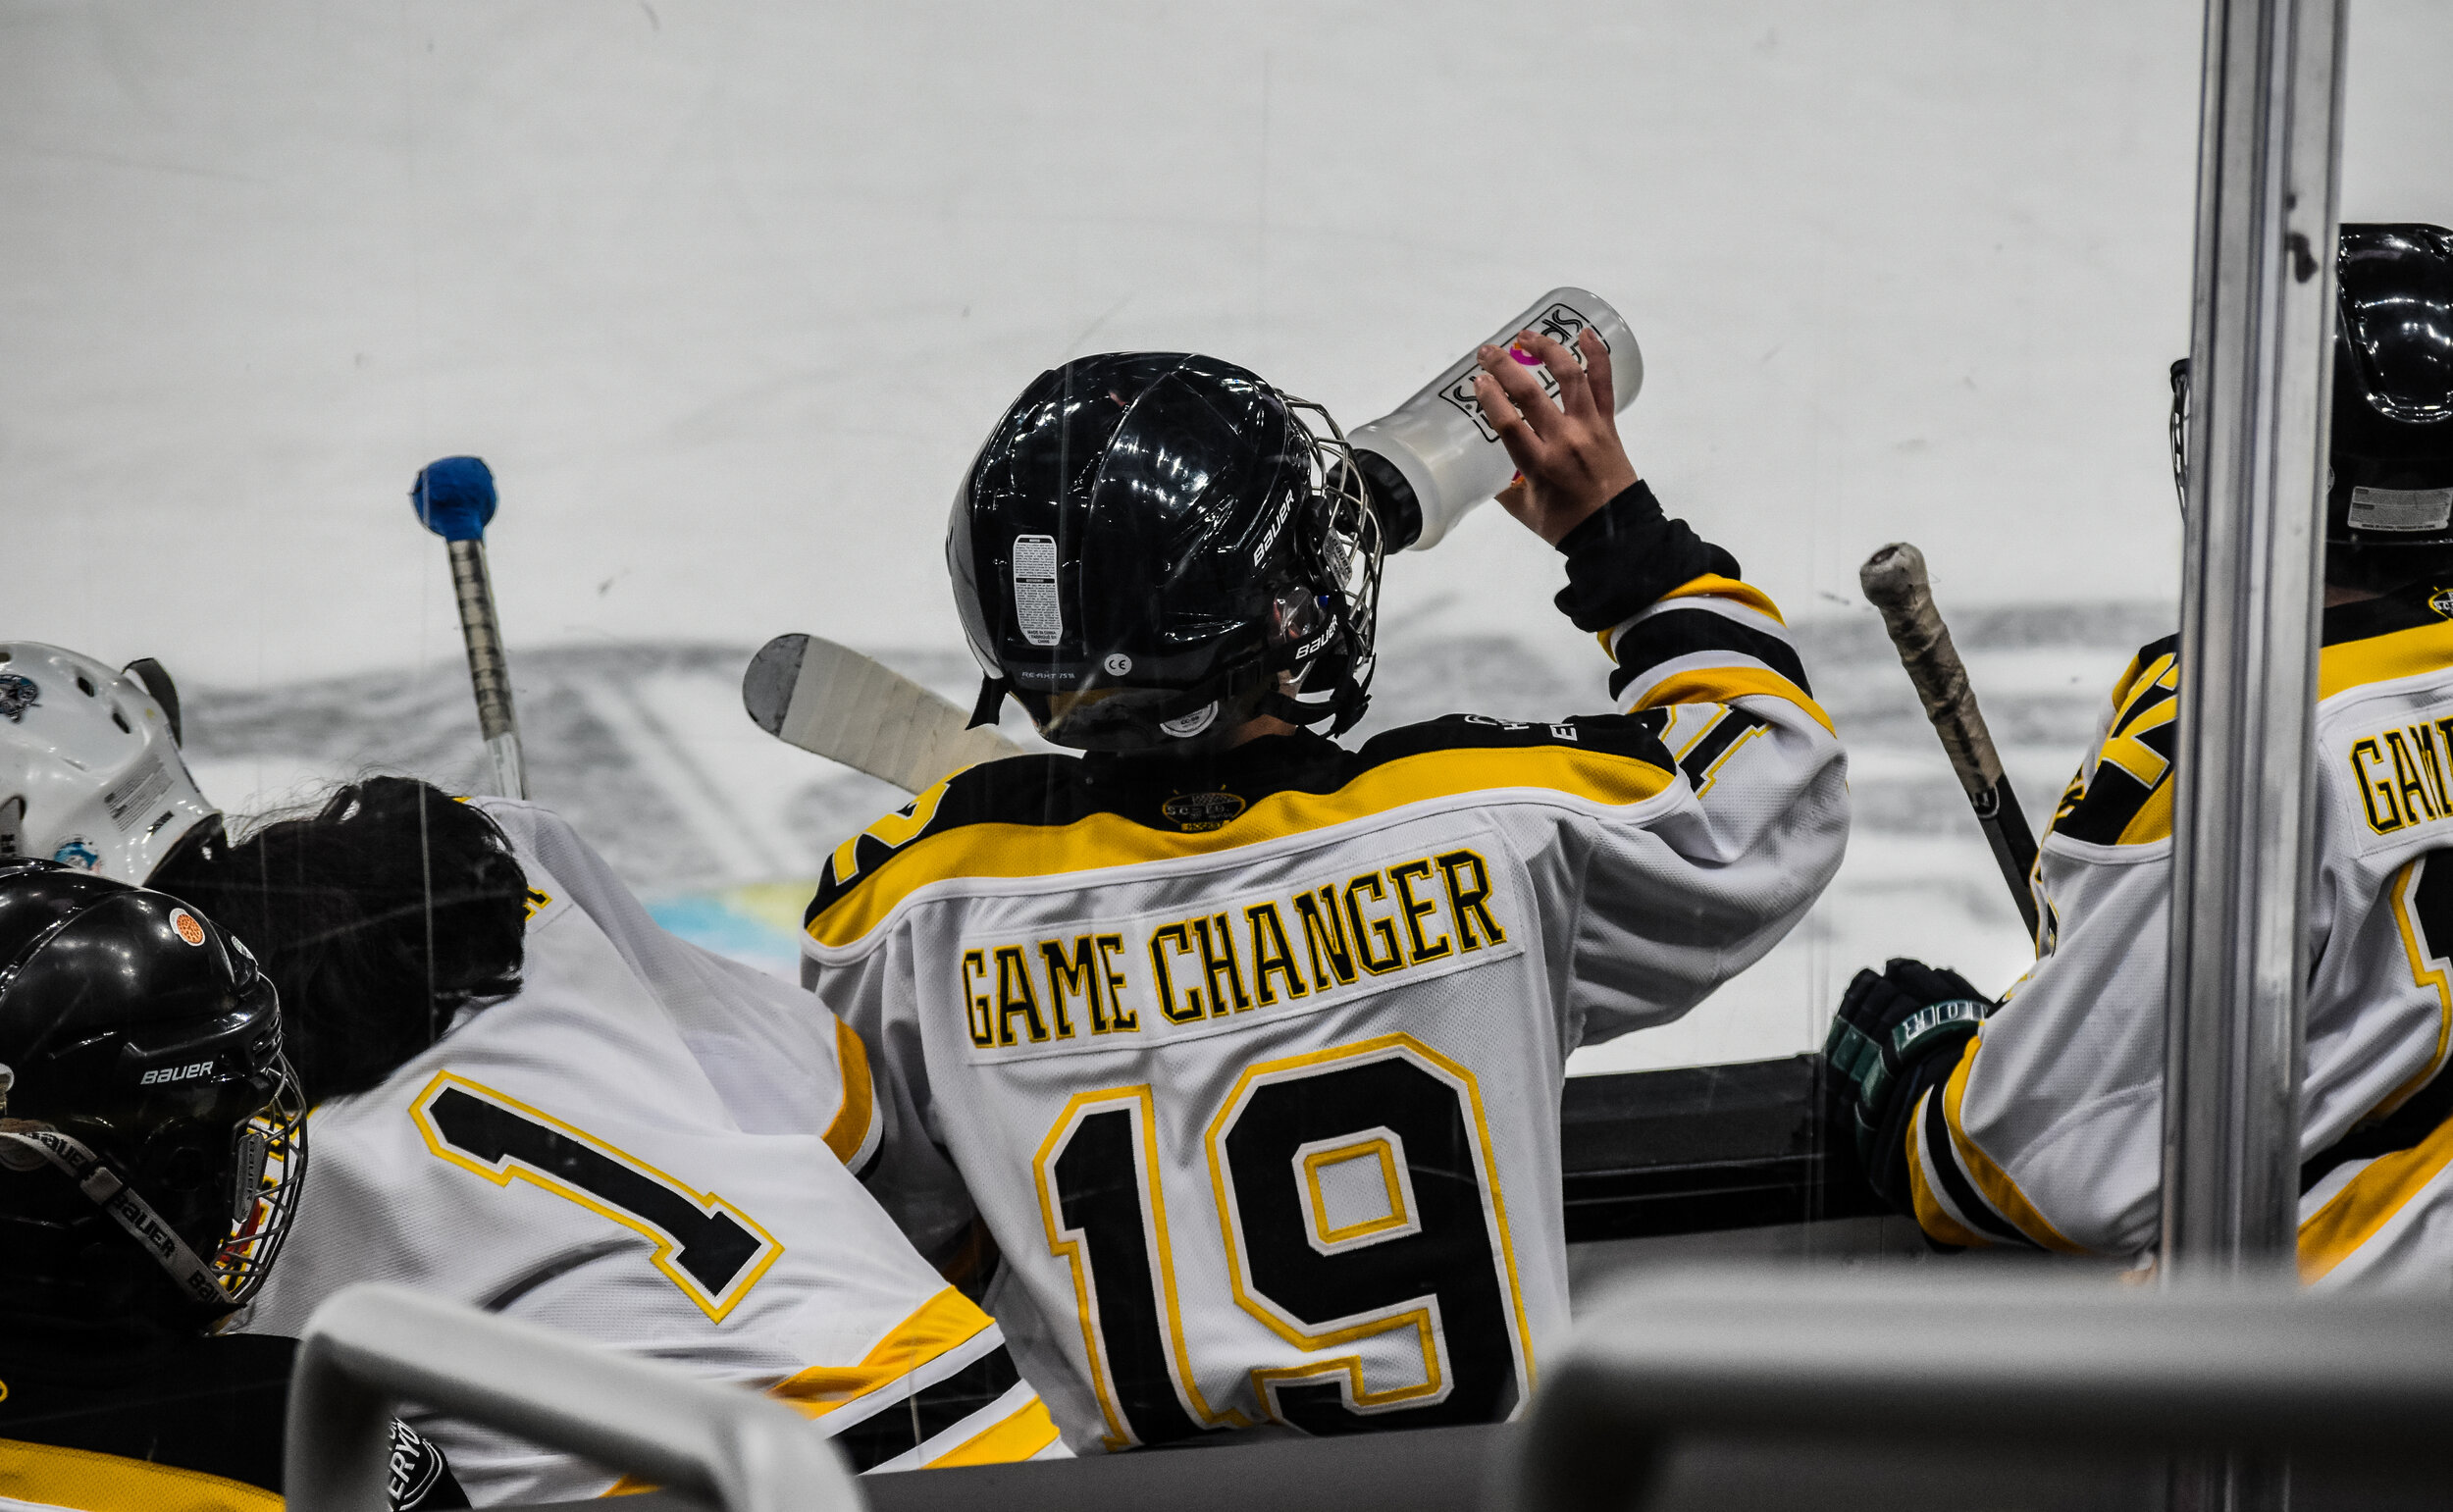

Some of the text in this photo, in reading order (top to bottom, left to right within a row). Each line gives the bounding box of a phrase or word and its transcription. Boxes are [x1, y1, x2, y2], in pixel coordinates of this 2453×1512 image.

[1253, 488, 1295, 568] BAUER
[1295, 613, 1338, 660] BAUER
[962, 848, 1507, 1050] GAME CHANGER
[140, 1061, 214, 1085] BAUER
[408, 1069, 785, 1326] 1
[1031, 1031, 1539, 1453] 19
[189, 1269, 221, 1305] BAU
